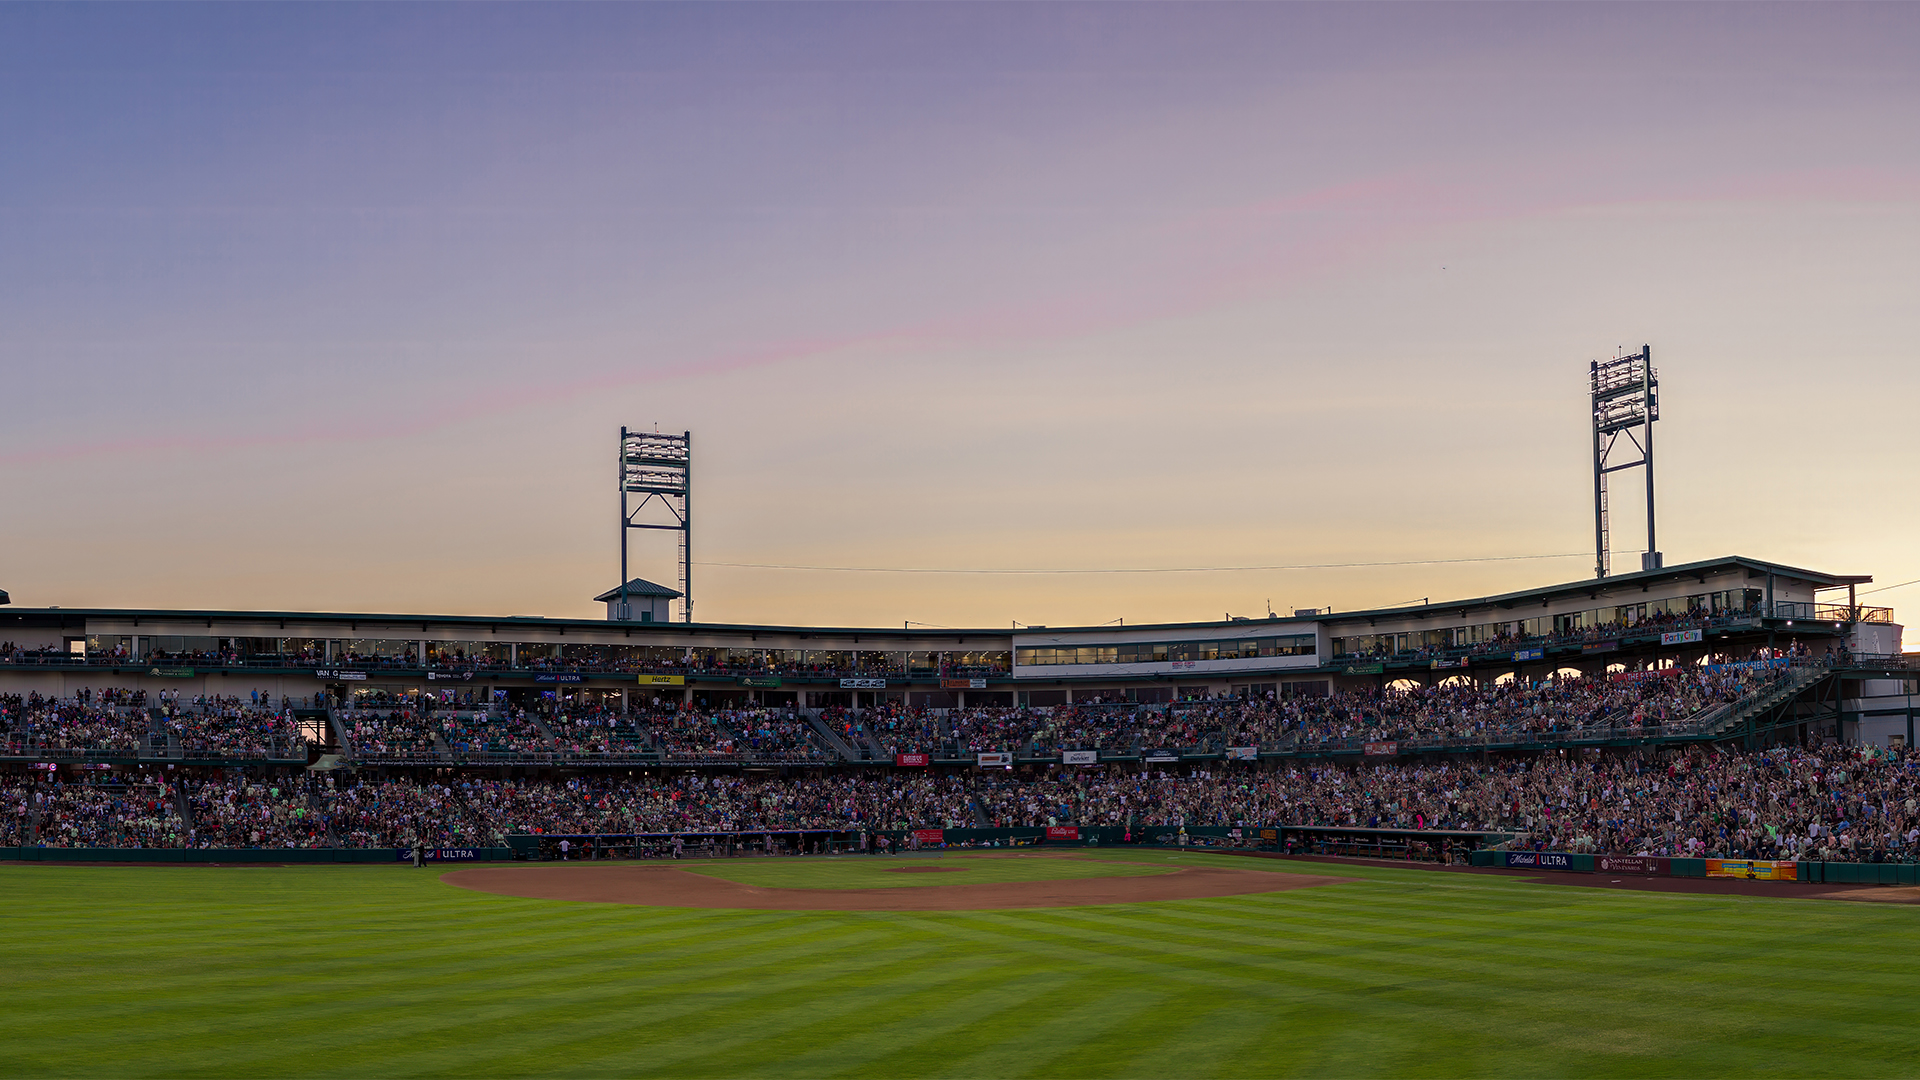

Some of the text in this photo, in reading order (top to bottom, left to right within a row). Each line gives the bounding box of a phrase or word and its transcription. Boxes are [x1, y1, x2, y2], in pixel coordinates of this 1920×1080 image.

[1627, 673, 1639, 681] THE
[443, 850, 474, 858] ULTRA
[1541, 855, 1567, 866] ULTRA
